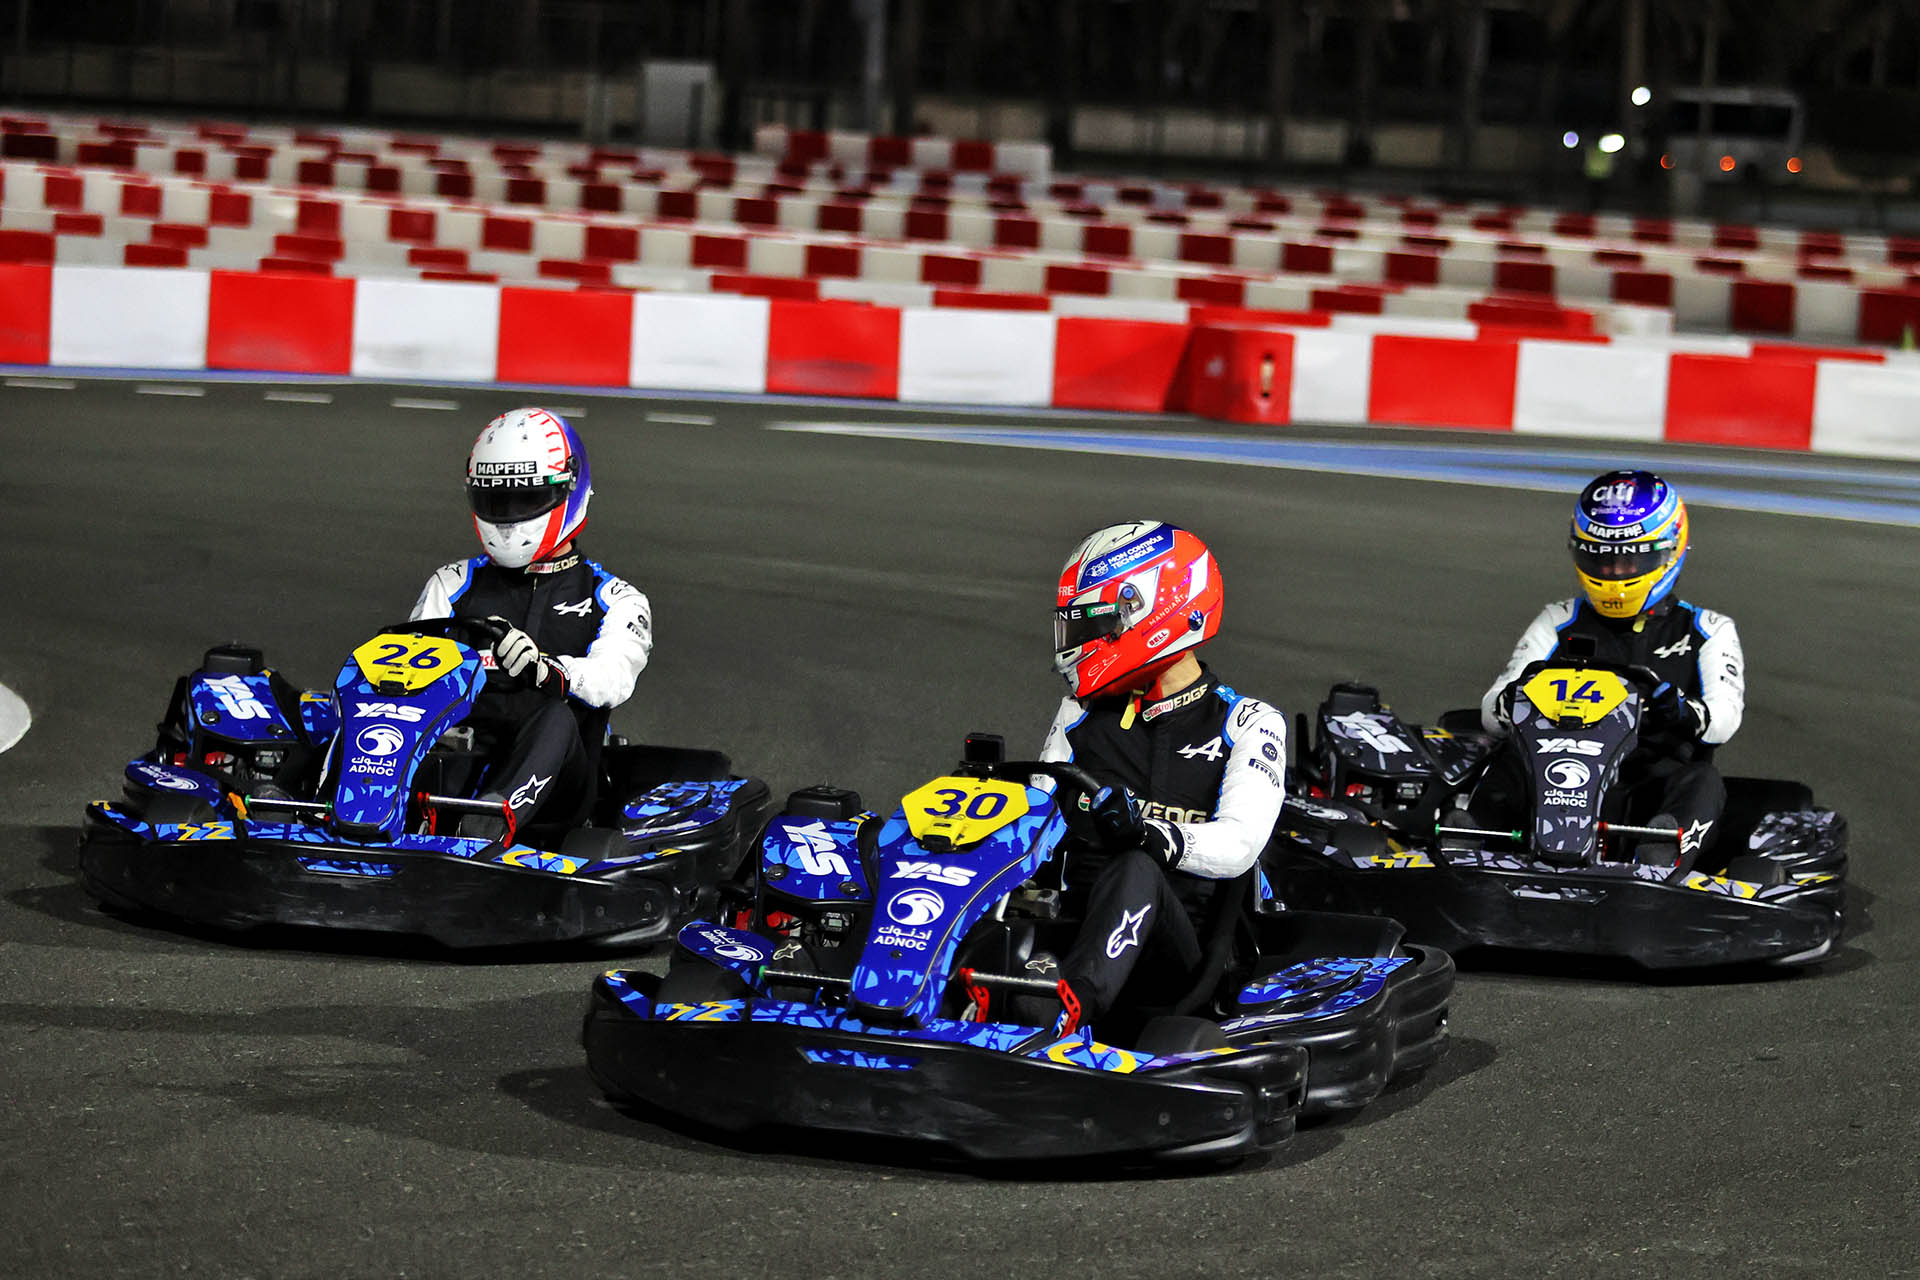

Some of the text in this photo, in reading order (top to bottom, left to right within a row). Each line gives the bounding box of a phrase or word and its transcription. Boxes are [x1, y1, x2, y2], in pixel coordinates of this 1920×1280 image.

[478, 462, 535, 474] MAPFRE
[472, 475, 544, 487] ALPINE
[1588, 523, 1643, 538] MAPFRE
[1579, 543, 1650, 554] ALPINE
[1108, 551, 1128, 565] MON
[1149, 594, 1185, 626] MANDIANT
[1149, 631, 1168, 646] BELL
[372, 644, 441, 669] 26
[203, 675, 271, 720] YAS
[1550, 680, 1604, 703] 14
[353, 703, 426, 722] YAS
[1536, 739, 1604, 756] YAS
[349, 765, 394, 776] ADNOC
[924, 789, 1008, 820] 30
[1544, 797, 1587, 807] ADNOC
[782, 822, 851, 876] YAS
[889, 861, 977, 887] YAS
[873, 935, 927, 951] ADNOC
